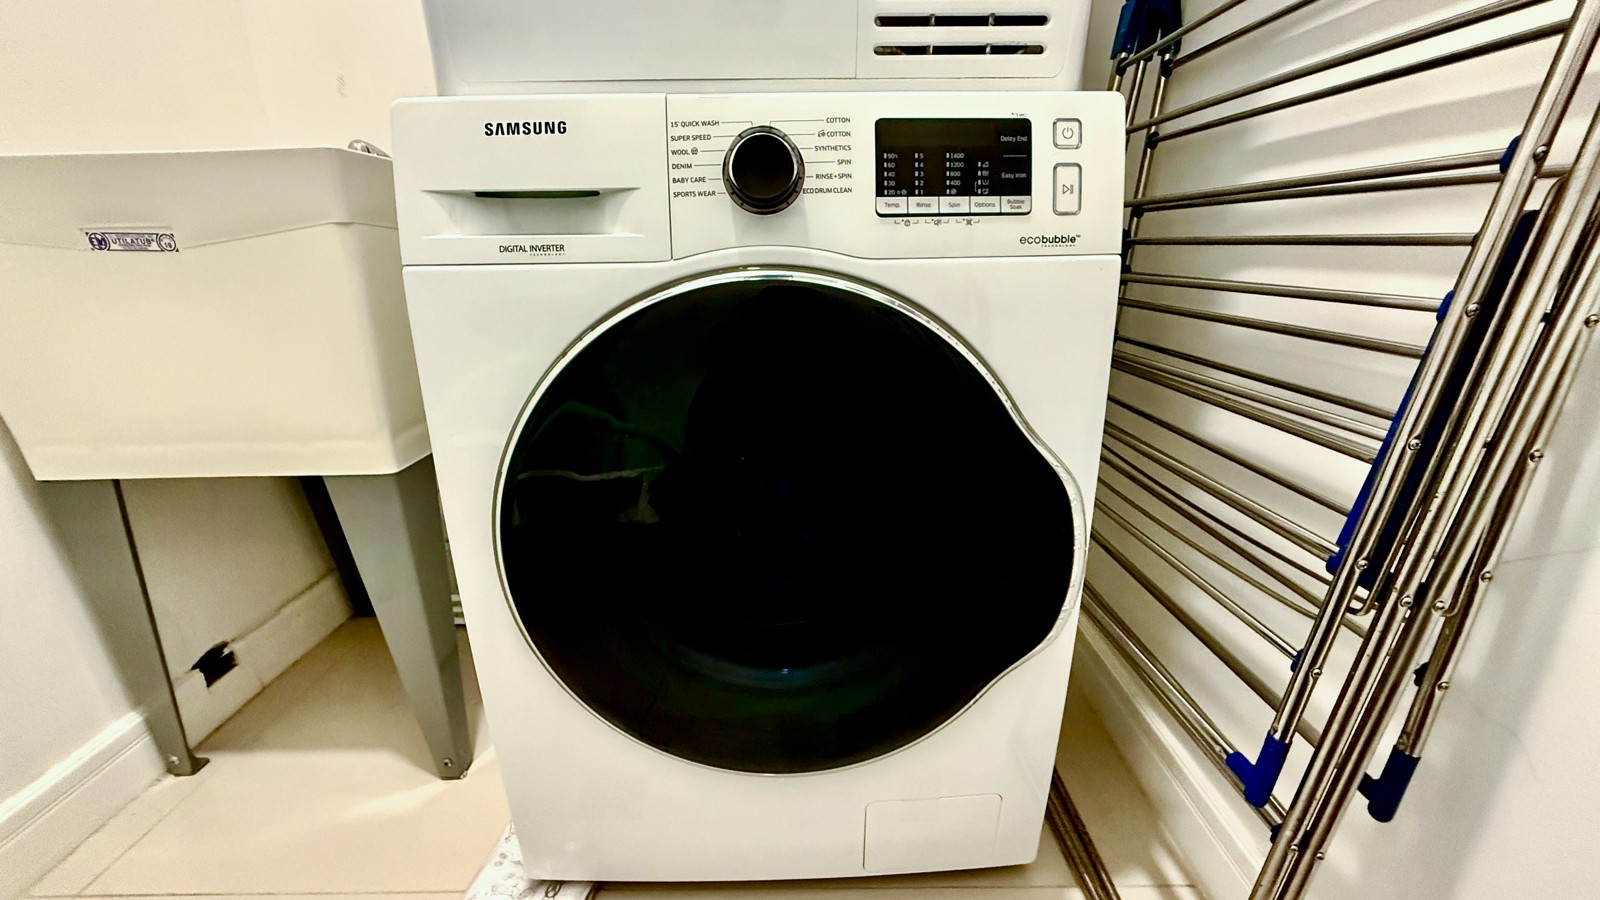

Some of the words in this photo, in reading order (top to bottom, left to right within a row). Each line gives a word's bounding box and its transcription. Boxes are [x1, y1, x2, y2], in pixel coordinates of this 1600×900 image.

[484, 121, 567, 136] SAMSUNG
[499, 244, 528, 253] DIGITAL
[530, 244, 565, 252] INVERTER
